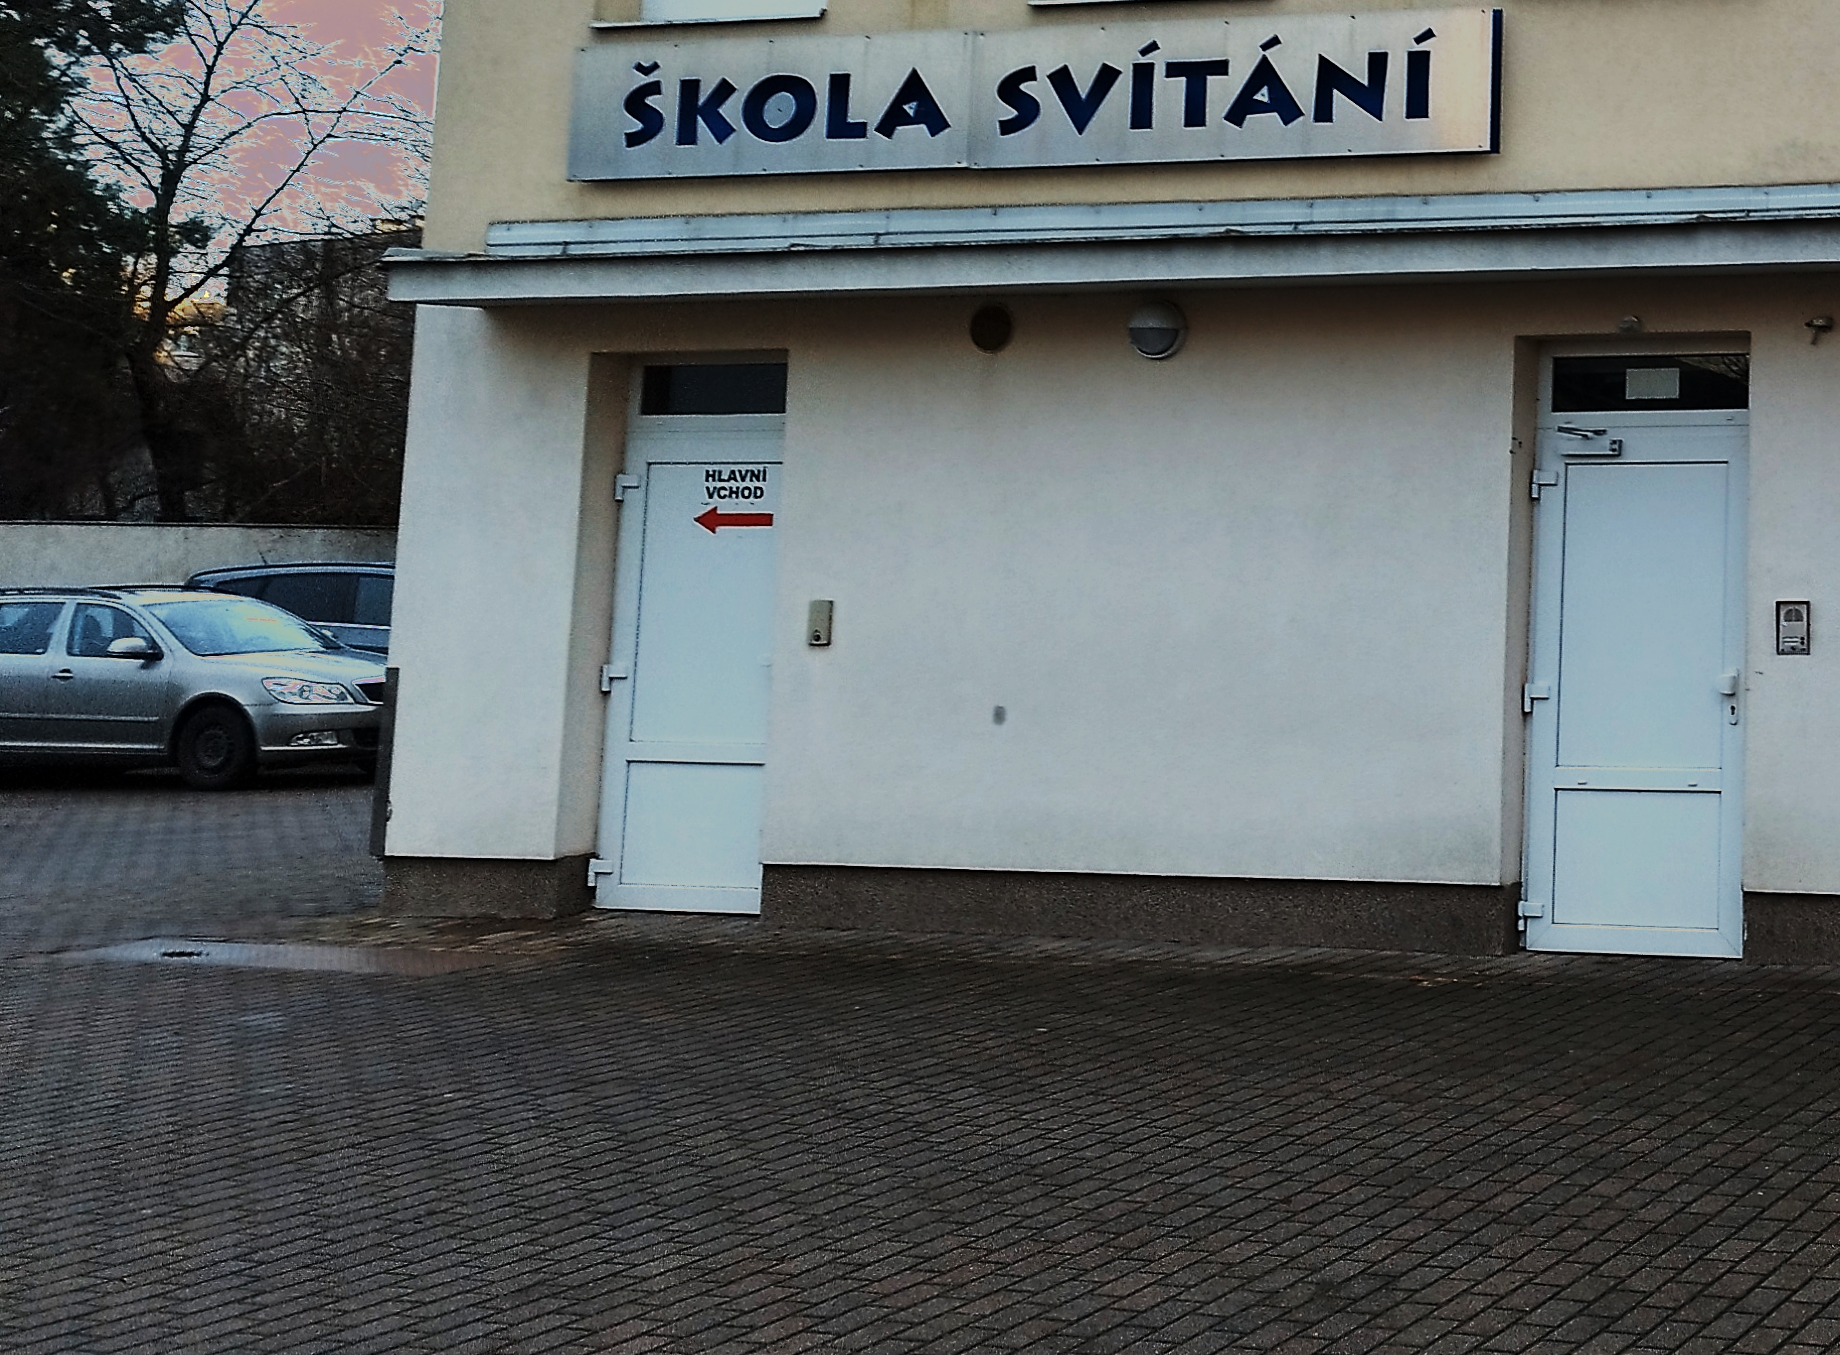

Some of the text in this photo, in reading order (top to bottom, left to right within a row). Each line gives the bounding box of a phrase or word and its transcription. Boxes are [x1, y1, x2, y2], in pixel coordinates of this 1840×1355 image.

[622, 26, 1438, 149] ŠKOLA SVÍTÁNÍ
[704, 466, 768, 483] HLAVNÍ
[705, 486, 764, 500] VCHOD
